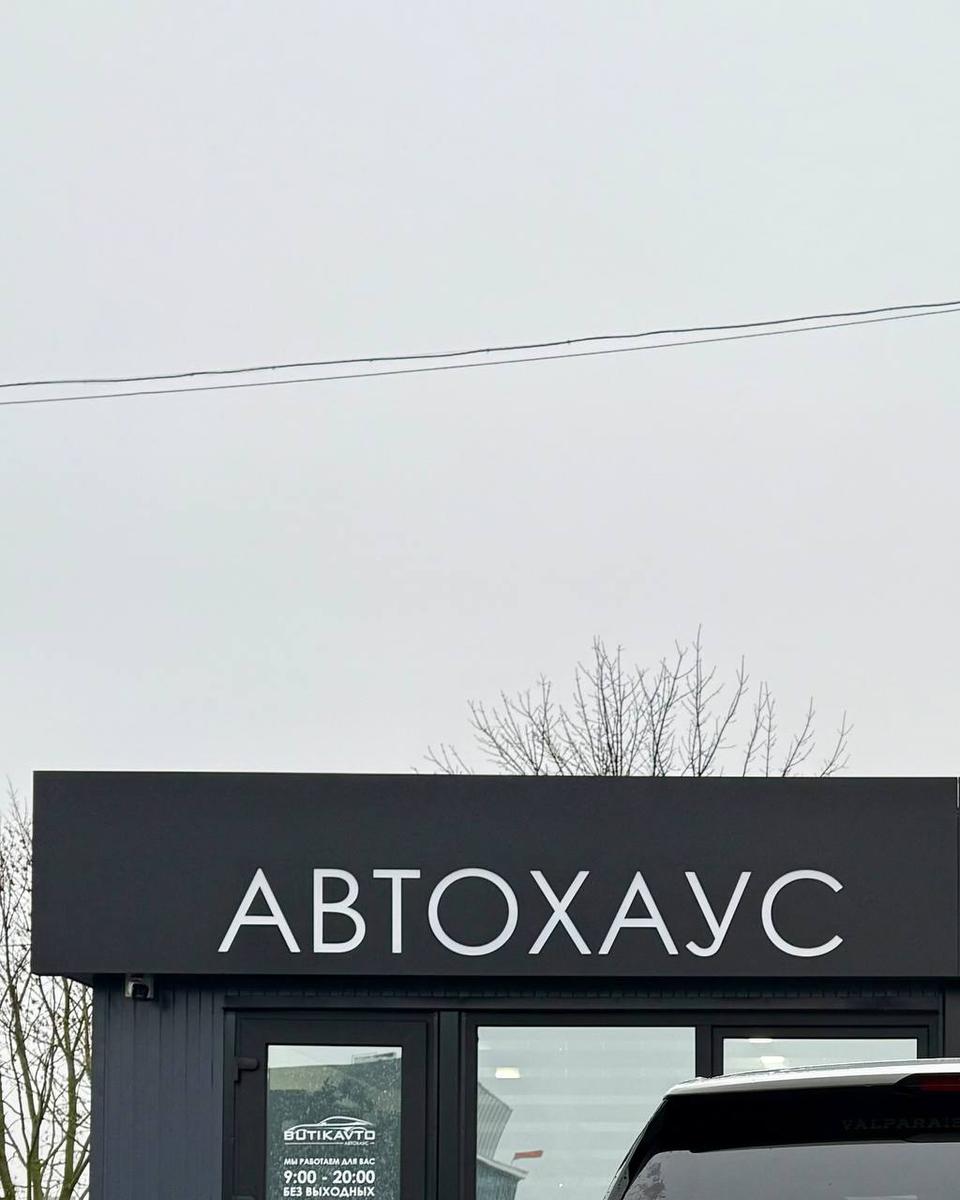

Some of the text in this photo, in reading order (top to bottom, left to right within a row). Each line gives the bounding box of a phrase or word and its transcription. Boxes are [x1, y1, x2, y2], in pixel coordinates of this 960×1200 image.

[218, 867, 844, 958] АВТОХАУС
[283, 1129, 376, 1141] BUTIKAVTO
[283, 1157, 298, 1166] МЫ
[299, 1157, 340, 1166] РАБОТАЕМ
[359, 1157, 376, 1166] ВАС
[283, 1170, 317, 1184] 9:00
[332, 1170, 376, 1184] 20:00
[283, 1186, 375, 1198] БЕЗ ВЫХОДНЫХ
